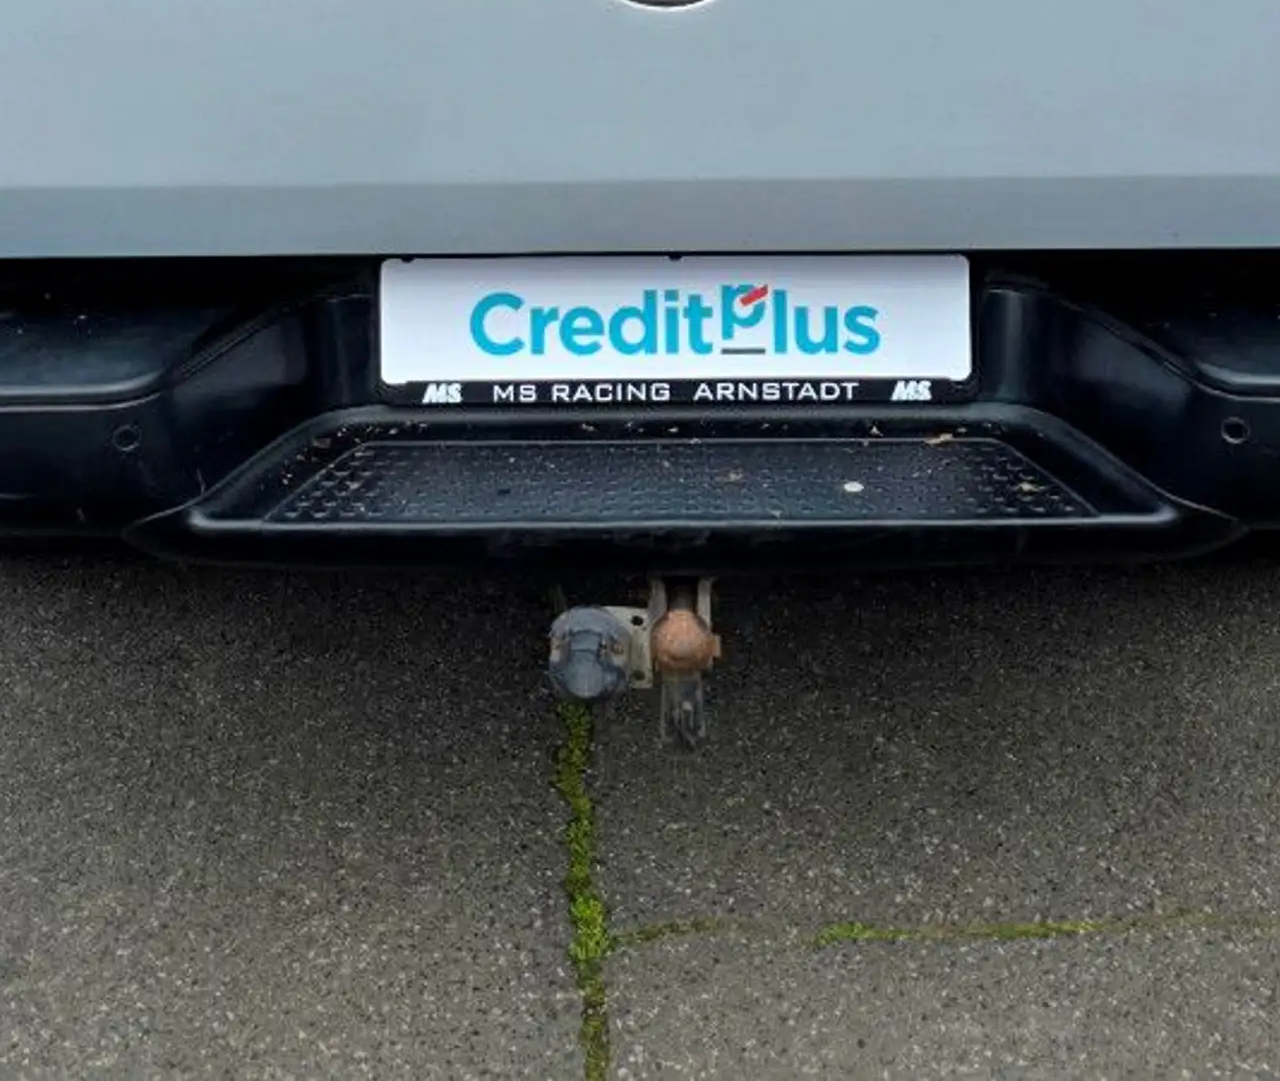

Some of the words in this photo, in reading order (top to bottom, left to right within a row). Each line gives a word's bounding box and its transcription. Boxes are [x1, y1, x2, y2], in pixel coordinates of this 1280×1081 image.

[470, 284, 881, 356] CreditPlus
[493, 384, 537, 401] MS
[552, 383, 671, 402] RACING
[693, 382, 859, 401] ARNSTADT
